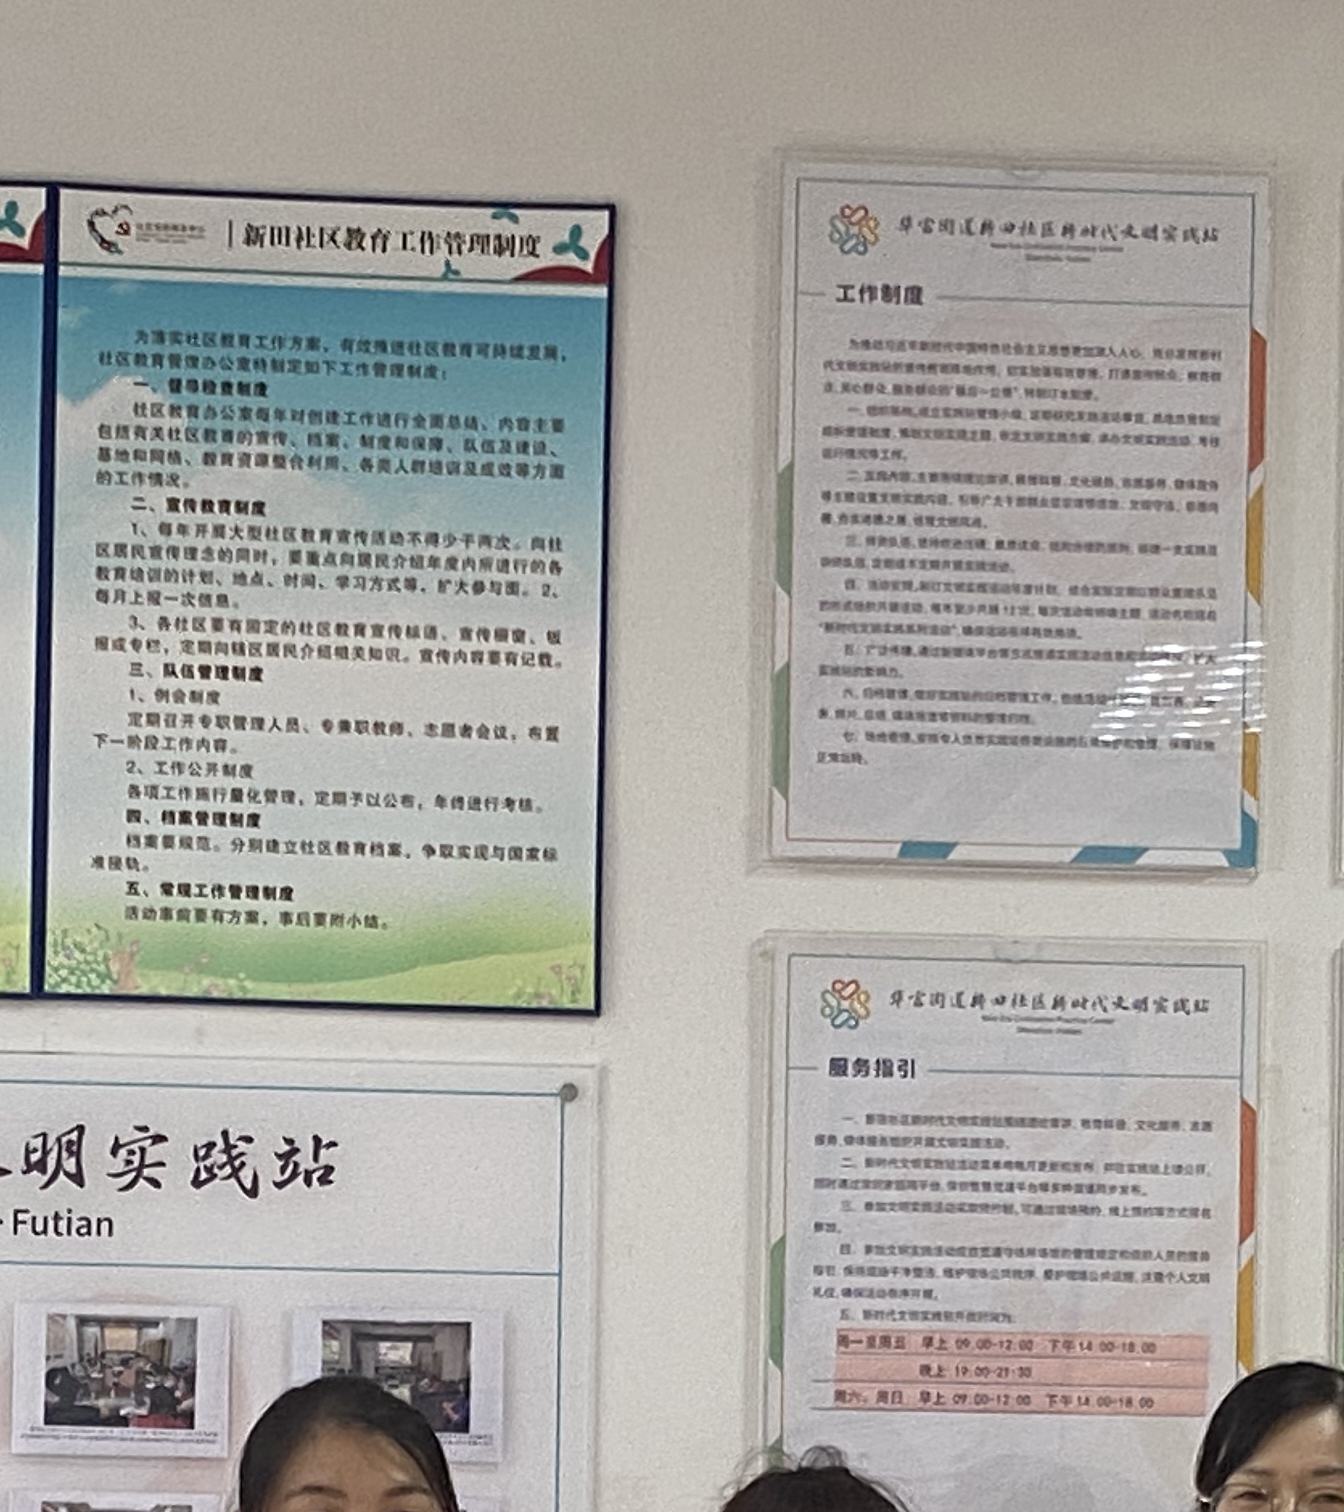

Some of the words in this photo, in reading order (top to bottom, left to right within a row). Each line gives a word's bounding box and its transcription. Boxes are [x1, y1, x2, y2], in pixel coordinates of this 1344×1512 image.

[241, 222, 542, 259] 新田社区教育工作管理制度
[836, 283, 924, 305] 工作制度
[827, 1057, 916, 1080] 服务指引
